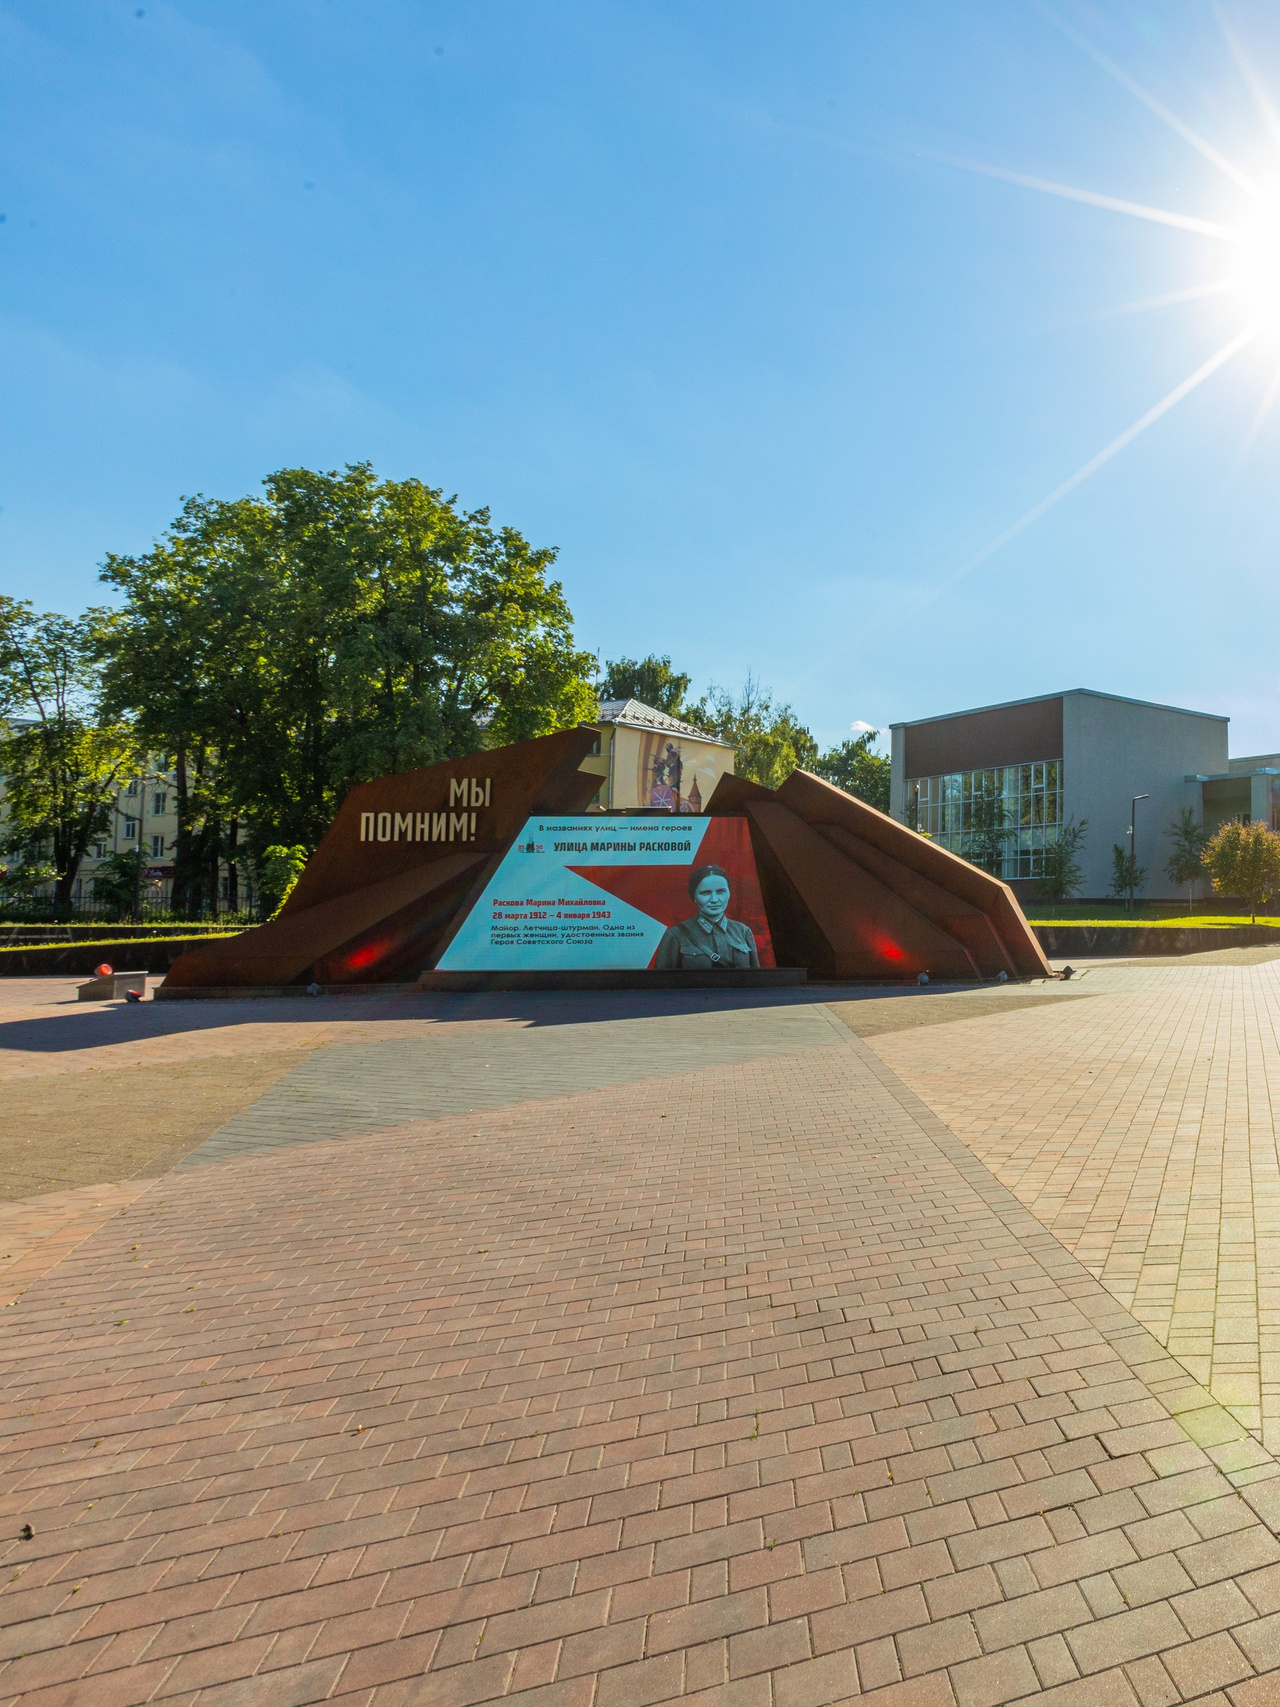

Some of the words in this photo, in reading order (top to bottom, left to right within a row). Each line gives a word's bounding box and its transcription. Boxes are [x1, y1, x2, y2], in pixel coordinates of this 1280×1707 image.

[449, 778, 491, 807] МЫ
[360, 812, 477, 842] ПОМНИМ!
[595, 825, 617, 833] улиц
[553, 842, 588, 853] УЛИЦА
[590, 841, 637, 852] МАРИНЫ
[639, 840, 692, 852] РАСКОВОЙ
[493, 899, 524, 907] Раскова
[526, 899, 556, 908] Марина
[557, 898, 606, 907] Михайловна
[492, 911, 503, 919] 28
[504, 912, 528, 921] марта
[529, 911, 547, 919] 1912
[555, 911, 562, 919] 4
[563, 912, 591, 921] января
[592, 911, 612, 919] 1943
[490, 924, 521, 932] Майор.
